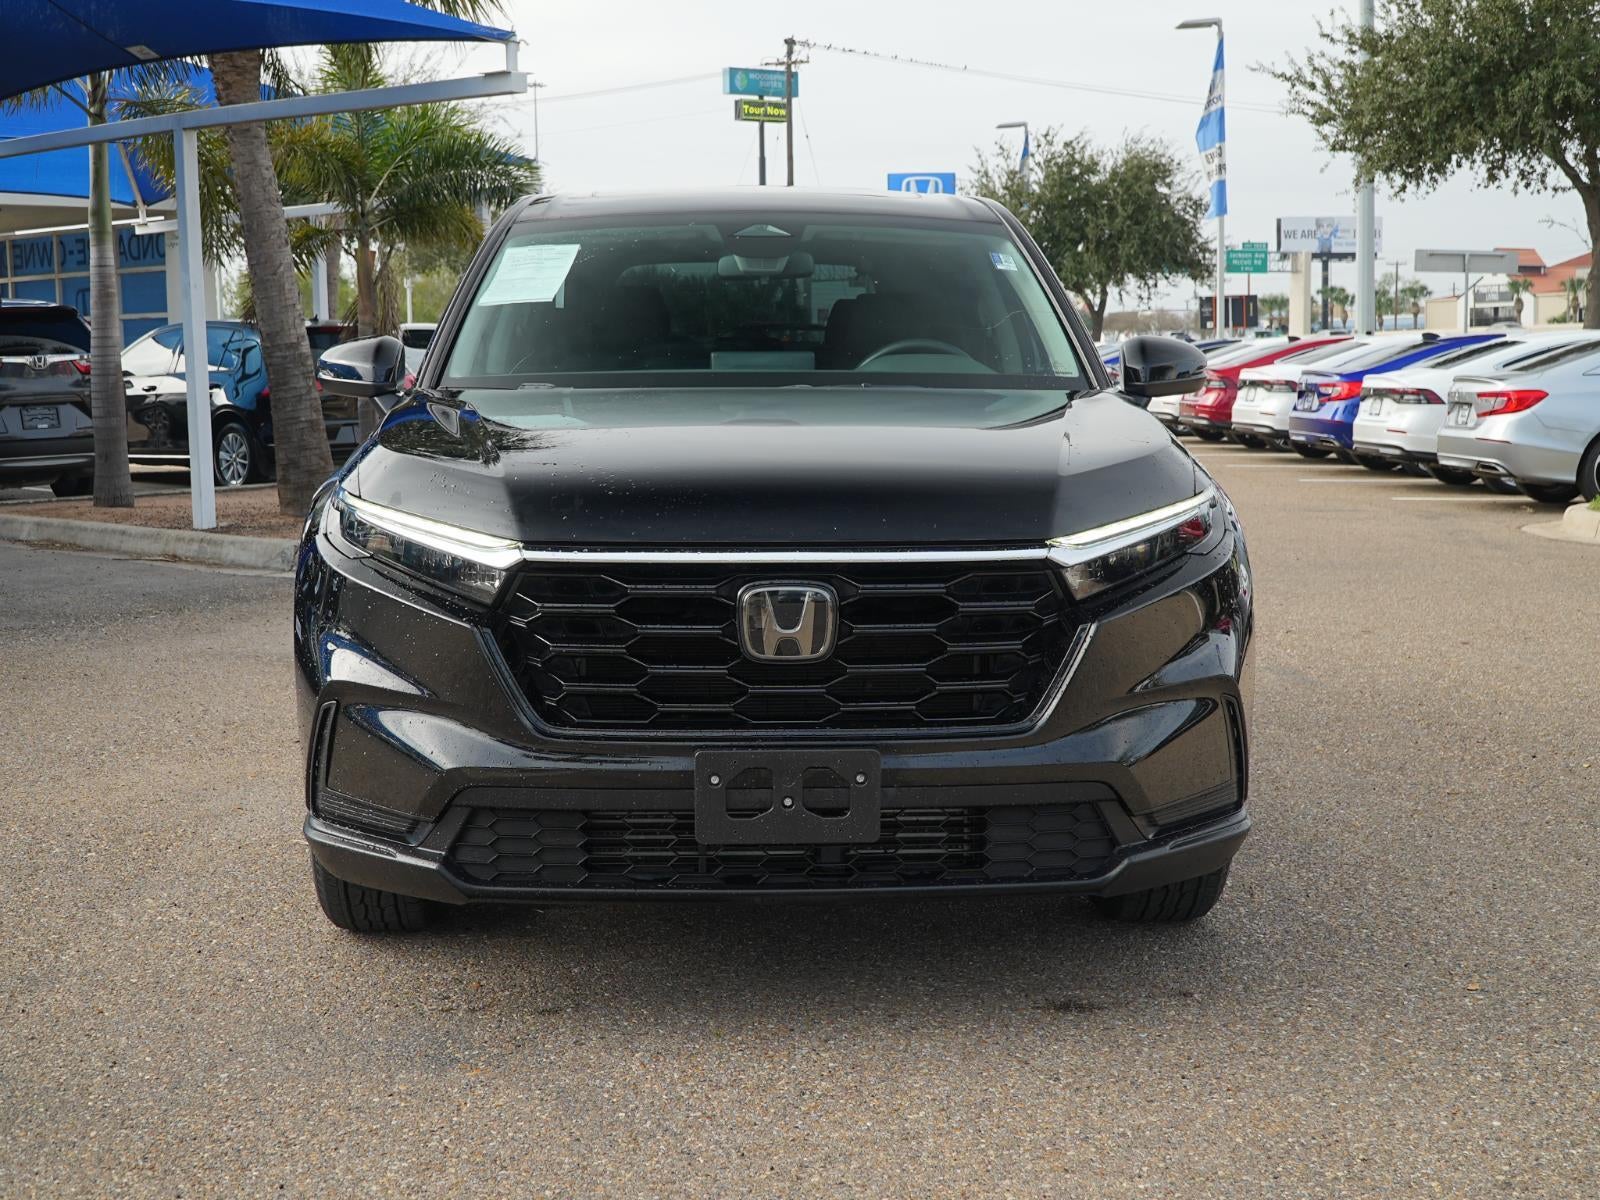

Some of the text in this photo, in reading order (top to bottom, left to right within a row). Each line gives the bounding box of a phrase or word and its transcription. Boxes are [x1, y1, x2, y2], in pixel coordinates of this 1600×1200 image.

[743, 104, 765, 115] Tour
[1283, 229, 1317, 240] WE ARE
